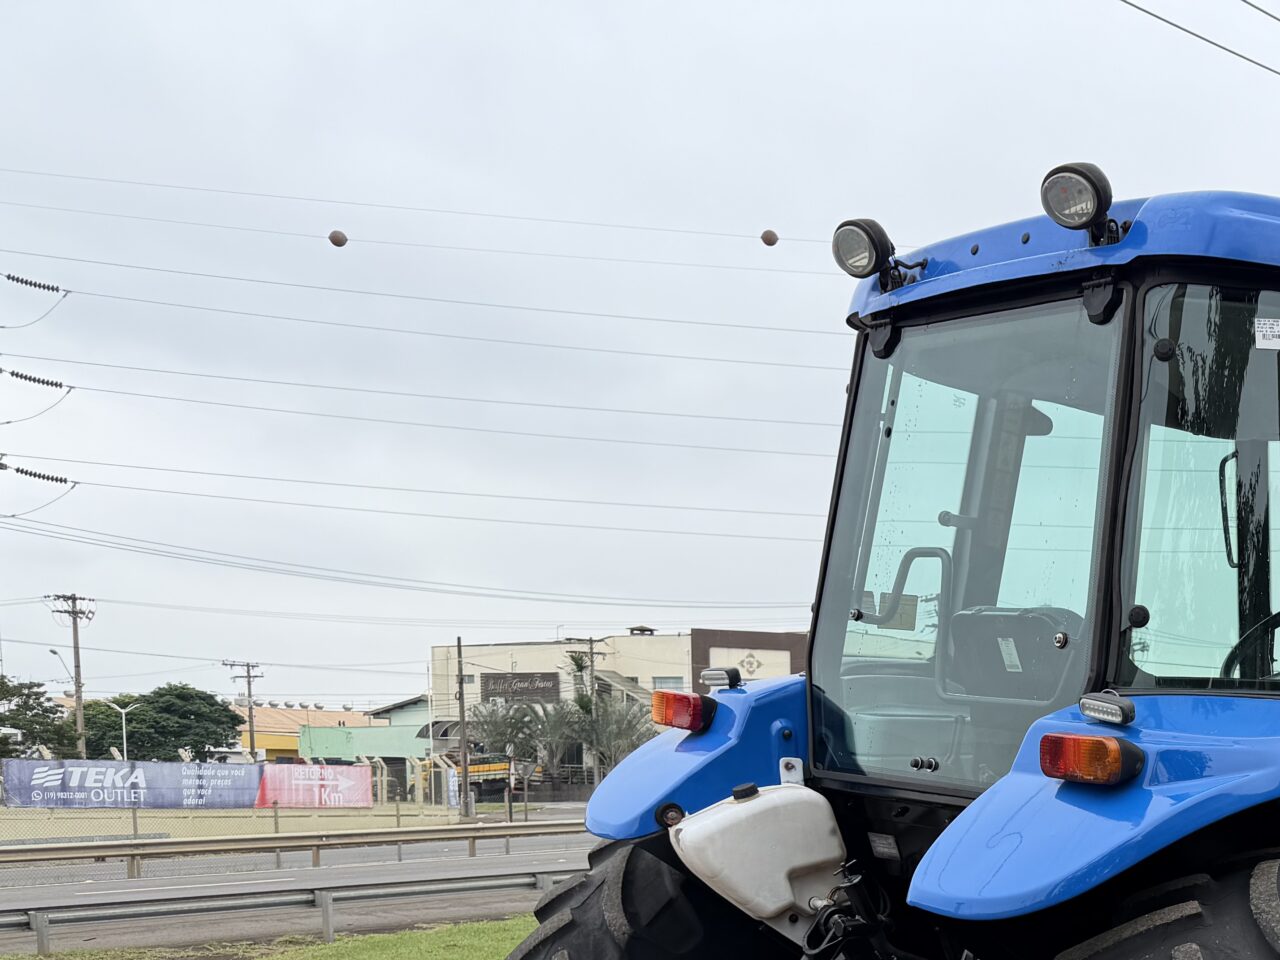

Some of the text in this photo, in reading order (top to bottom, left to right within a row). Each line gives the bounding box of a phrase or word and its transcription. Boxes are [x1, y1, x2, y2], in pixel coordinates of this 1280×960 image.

[67, 766, 147, 787] TEKA
[181, 766, 215, 776] Qualidade
[216, 768, 229, 777] que
[294, 767, 334, 779] RETORNO
[44, 791, 56, 800] (19)
[90, 788, 147, 802] OUTLET
[182, 787, 196, 796] que
